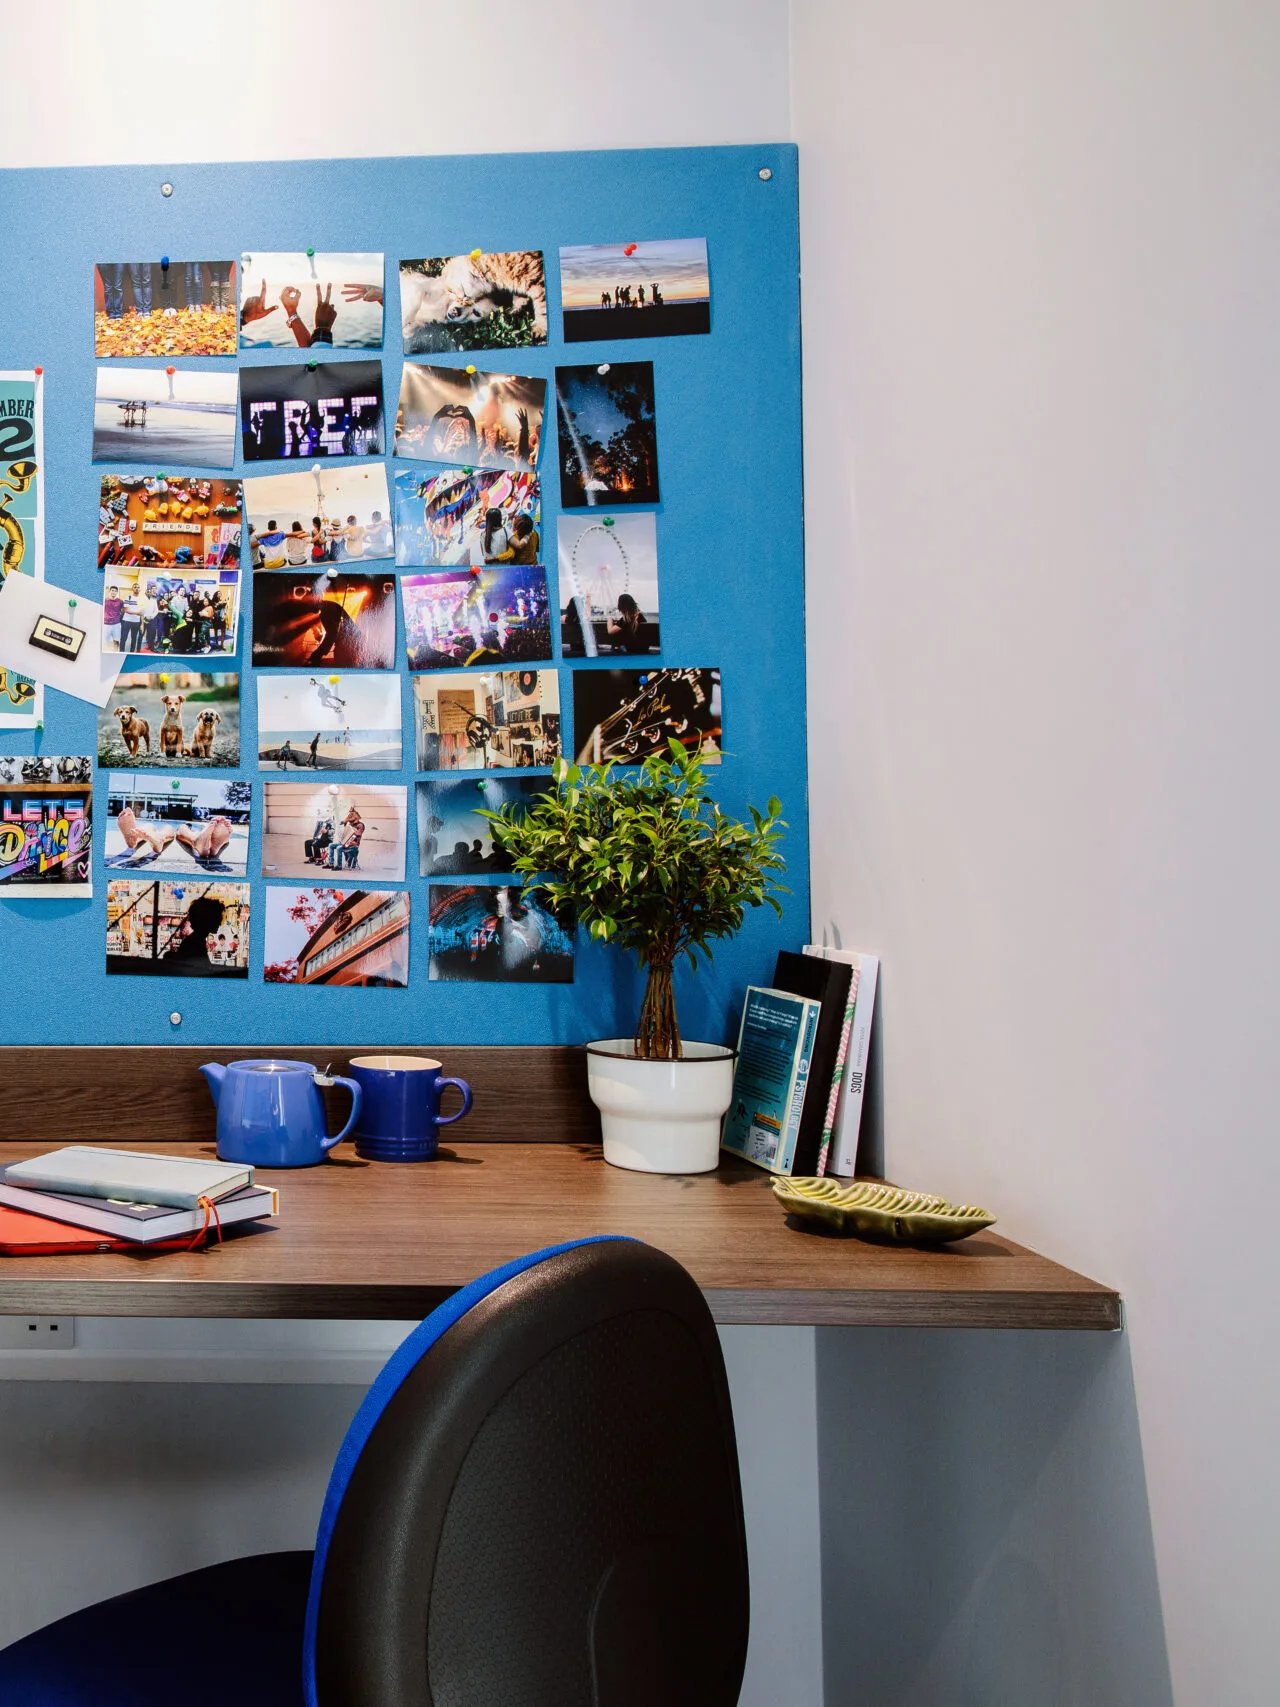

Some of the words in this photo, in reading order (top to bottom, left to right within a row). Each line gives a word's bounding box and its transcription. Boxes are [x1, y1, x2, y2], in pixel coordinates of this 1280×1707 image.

[144, 523, 200, 532] FRIENDS
[3, 799, 84, 822] LETS
[804, 1017, 815, 1053] INTRODUCING
[850, 1071, 863, 1094] DOGS
